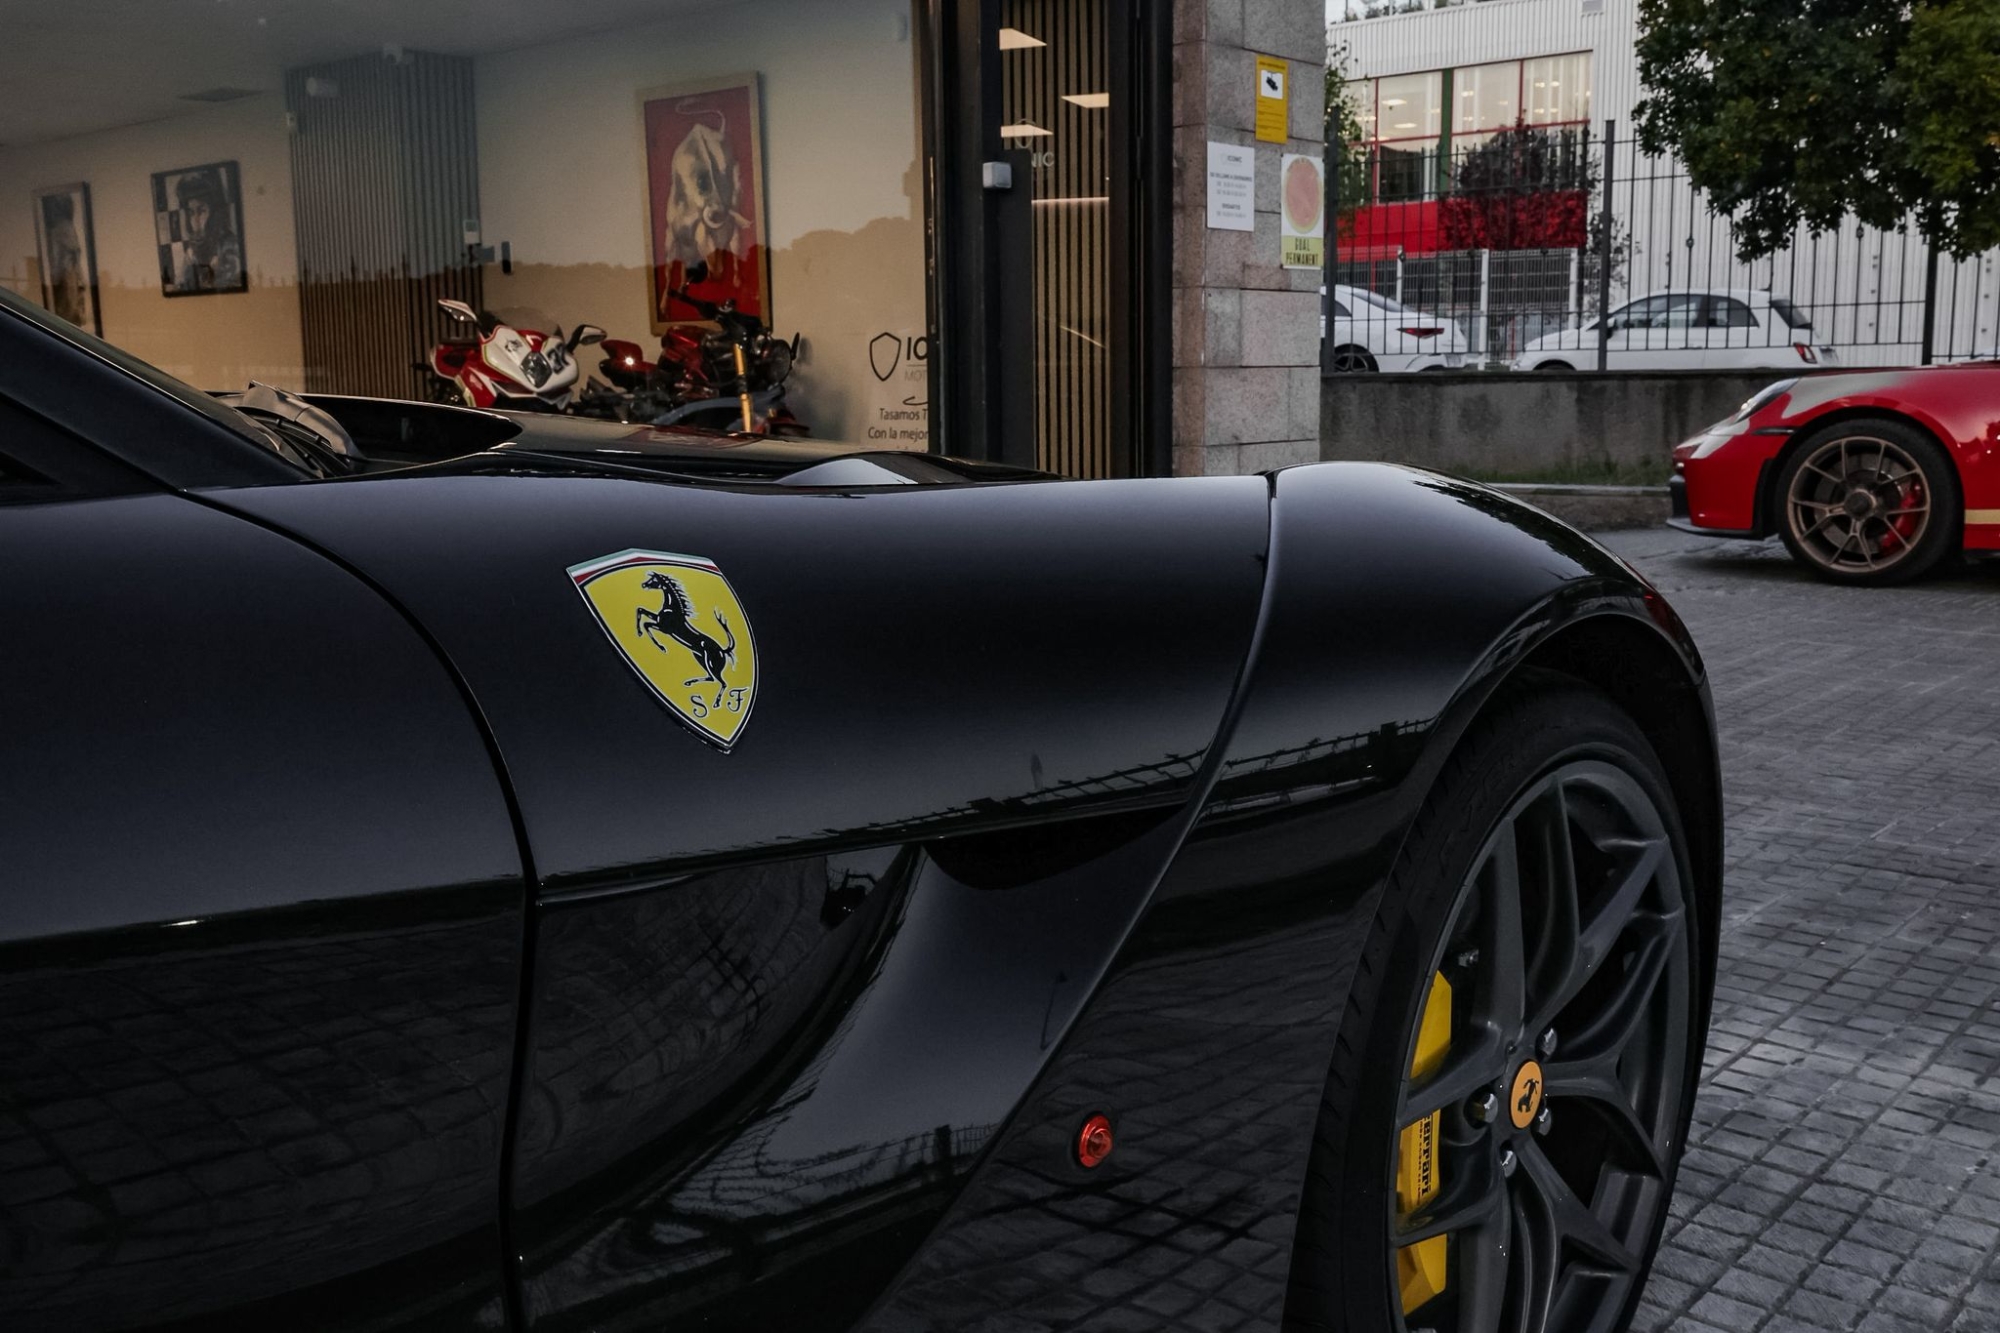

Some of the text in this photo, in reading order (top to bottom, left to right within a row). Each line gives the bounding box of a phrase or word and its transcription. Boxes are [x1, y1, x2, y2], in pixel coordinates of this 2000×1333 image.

[1285, 251, 1319, 266] PERMANENT
[879, 408, 920, 421] Tasamos
[868, 426, 887, 440] Con
[889, 427, 898, 440] la
[690, 687, 749, 718] S F
